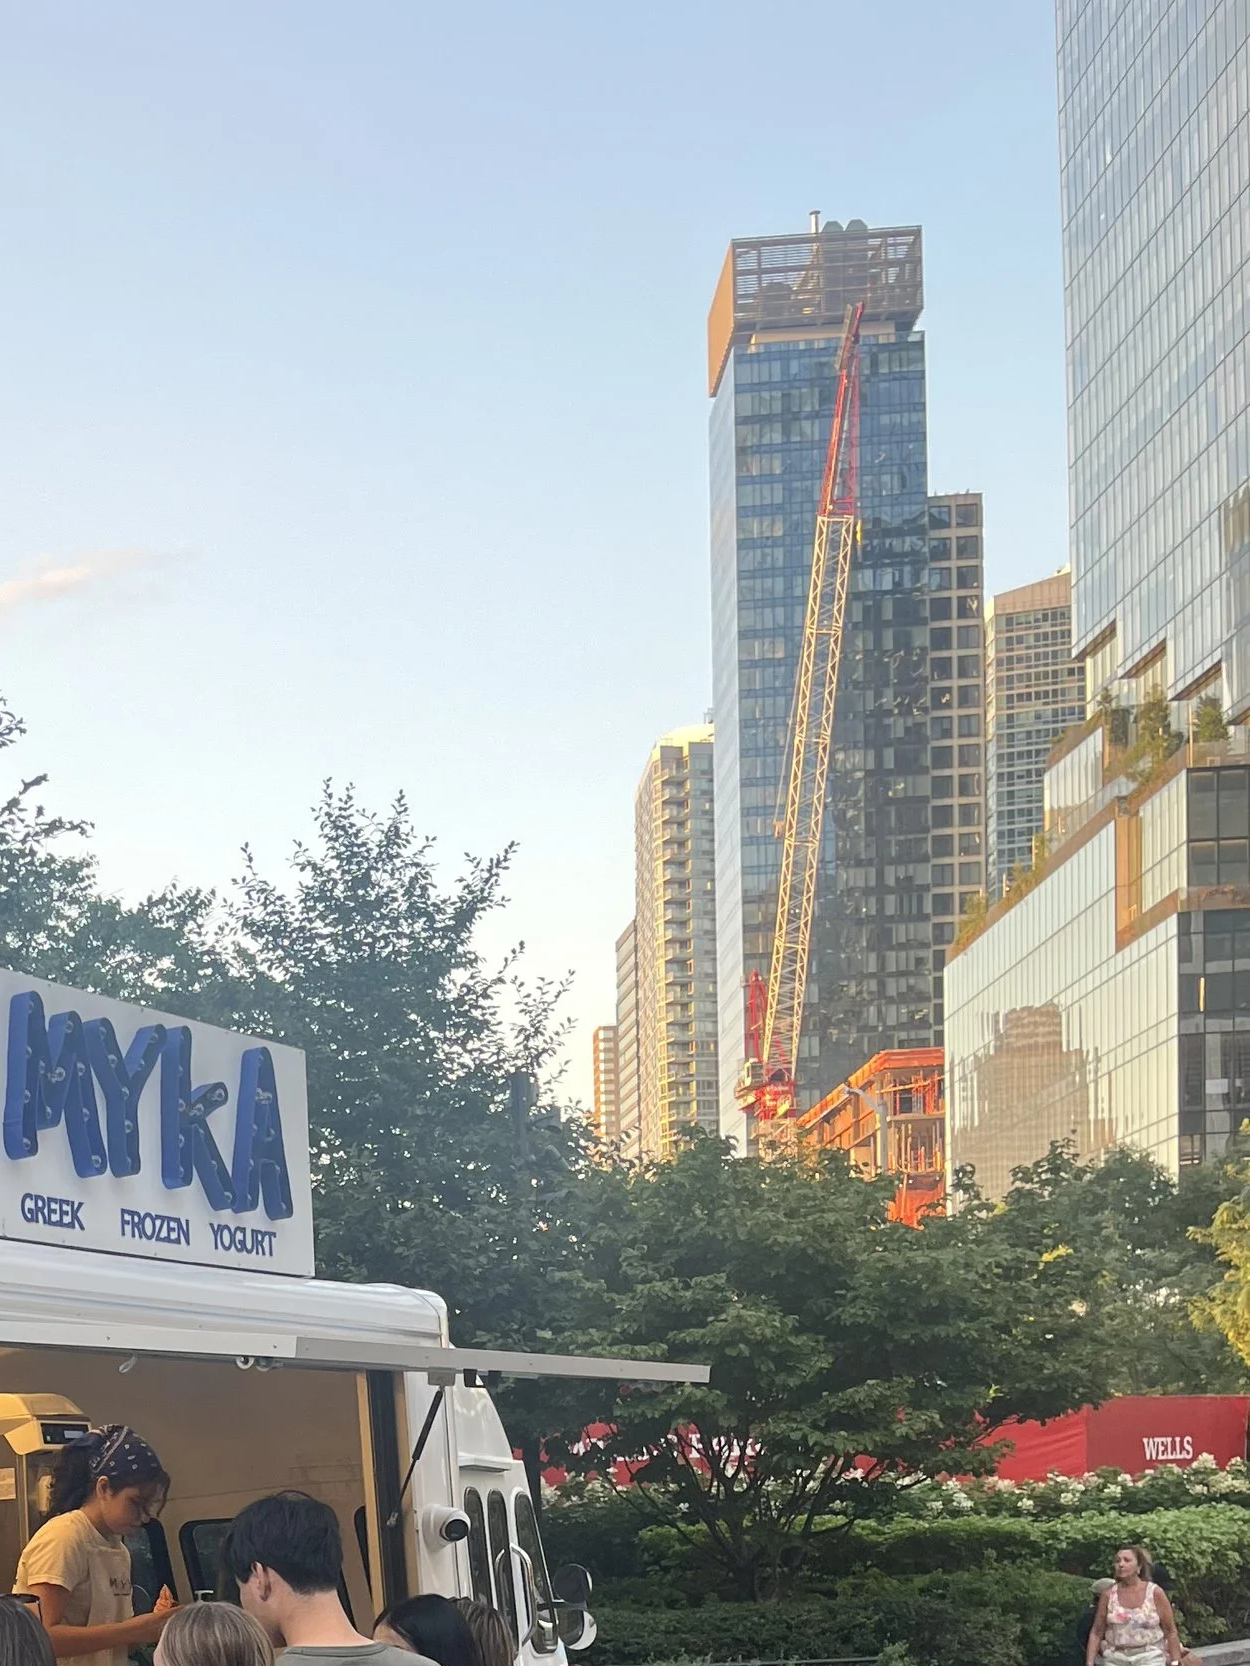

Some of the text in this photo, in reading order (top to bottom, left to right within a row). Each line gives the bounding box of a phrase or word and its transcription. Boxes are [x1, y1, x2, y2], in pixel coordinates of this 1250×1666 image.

[21, 1192, 277, 1257] GREEK FROZEN YOGURT
[1142, 1435, 1194, 1461] WELLS
